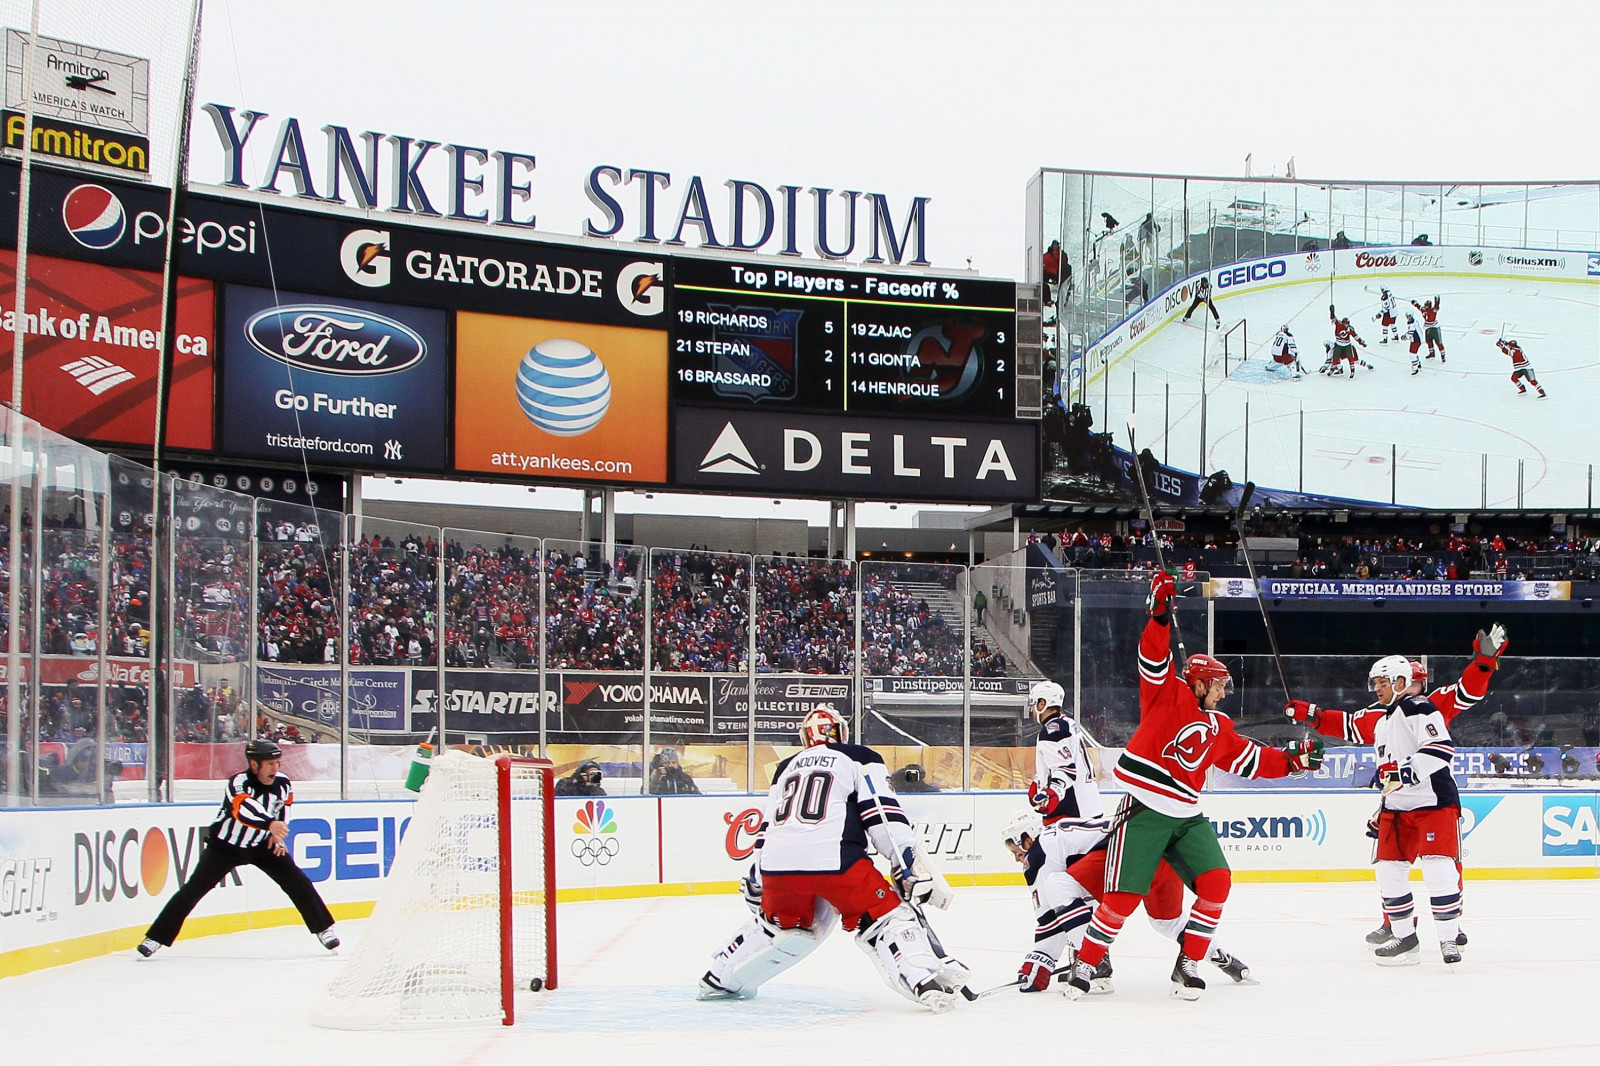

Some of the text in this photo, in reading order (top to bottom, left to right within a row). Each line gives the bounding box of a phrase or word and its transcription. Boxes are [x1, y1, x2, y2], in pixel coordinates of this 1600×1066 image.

[47, 54, 110, 81] Armitron
[90, 103, 125, 119] WATCH
[6, 115, 147, 170] Armitron
[201, 102, 932, 267] YANKEE STADIUM
[134, 211, 256, 254] pepsi
[1355, 251, 1442, 269] Coors LIGHT
[340, 229, 664, 316] G GATORADE G
[731, 266, 768, 288] Top
[774, 270, 845, 293] Players
[865, 277, 937, 298] Faceoff
[942, 282, 960, 299] %
[1217, 259, 1287, 290] GEICO
[1165, 280, 1201, 314] DISCOVE
[0, 306, 208, 357] ank of Amerca
[677, 310, 694, 323] 19
[696, 311, 768, 329] RICHARDS
[824, 321, 833, 333] 5
[850, 323, 1005, 344] 19 ZAJAC 3
[283, 313, 391, 366] Ford
[676, 340, 833, 362] 21 STEPAN 2
[850, 352, 1005, 372] 11 GIONTA 2
[677, 369, 832, 391] 16 BRASSARD 1
[850, 381, 1004, 400] 14 HENRIQUE 1
[275, 389, 397, 420] Go Further
[266, 432, 374, 455] tristateford.com
[783, 428, 1018, 482] DELTA
[491, 450, 633, 475] att.yankees.com
[193, 496, 227, 513] York
[1271, 582, 1503, 596] OFFICIAL MERCHANDISE STORE
[300, 676, 330, 687] Circle
[365, 678, 398, 688] Center
[718, 678, 777, 705] Yankees
[787, 685, 847, 697] STEINER
[892, 678, 1003, 692] pinstripebowl.com
[449, 689, 558, 714] STARTER
[598, 684, 704, 705] YOKOHAMA
[1425, 723, 1438, 738] 8
[773, 770, 834, 827] 30
[1246, 844, 1283, 852] RADIO
